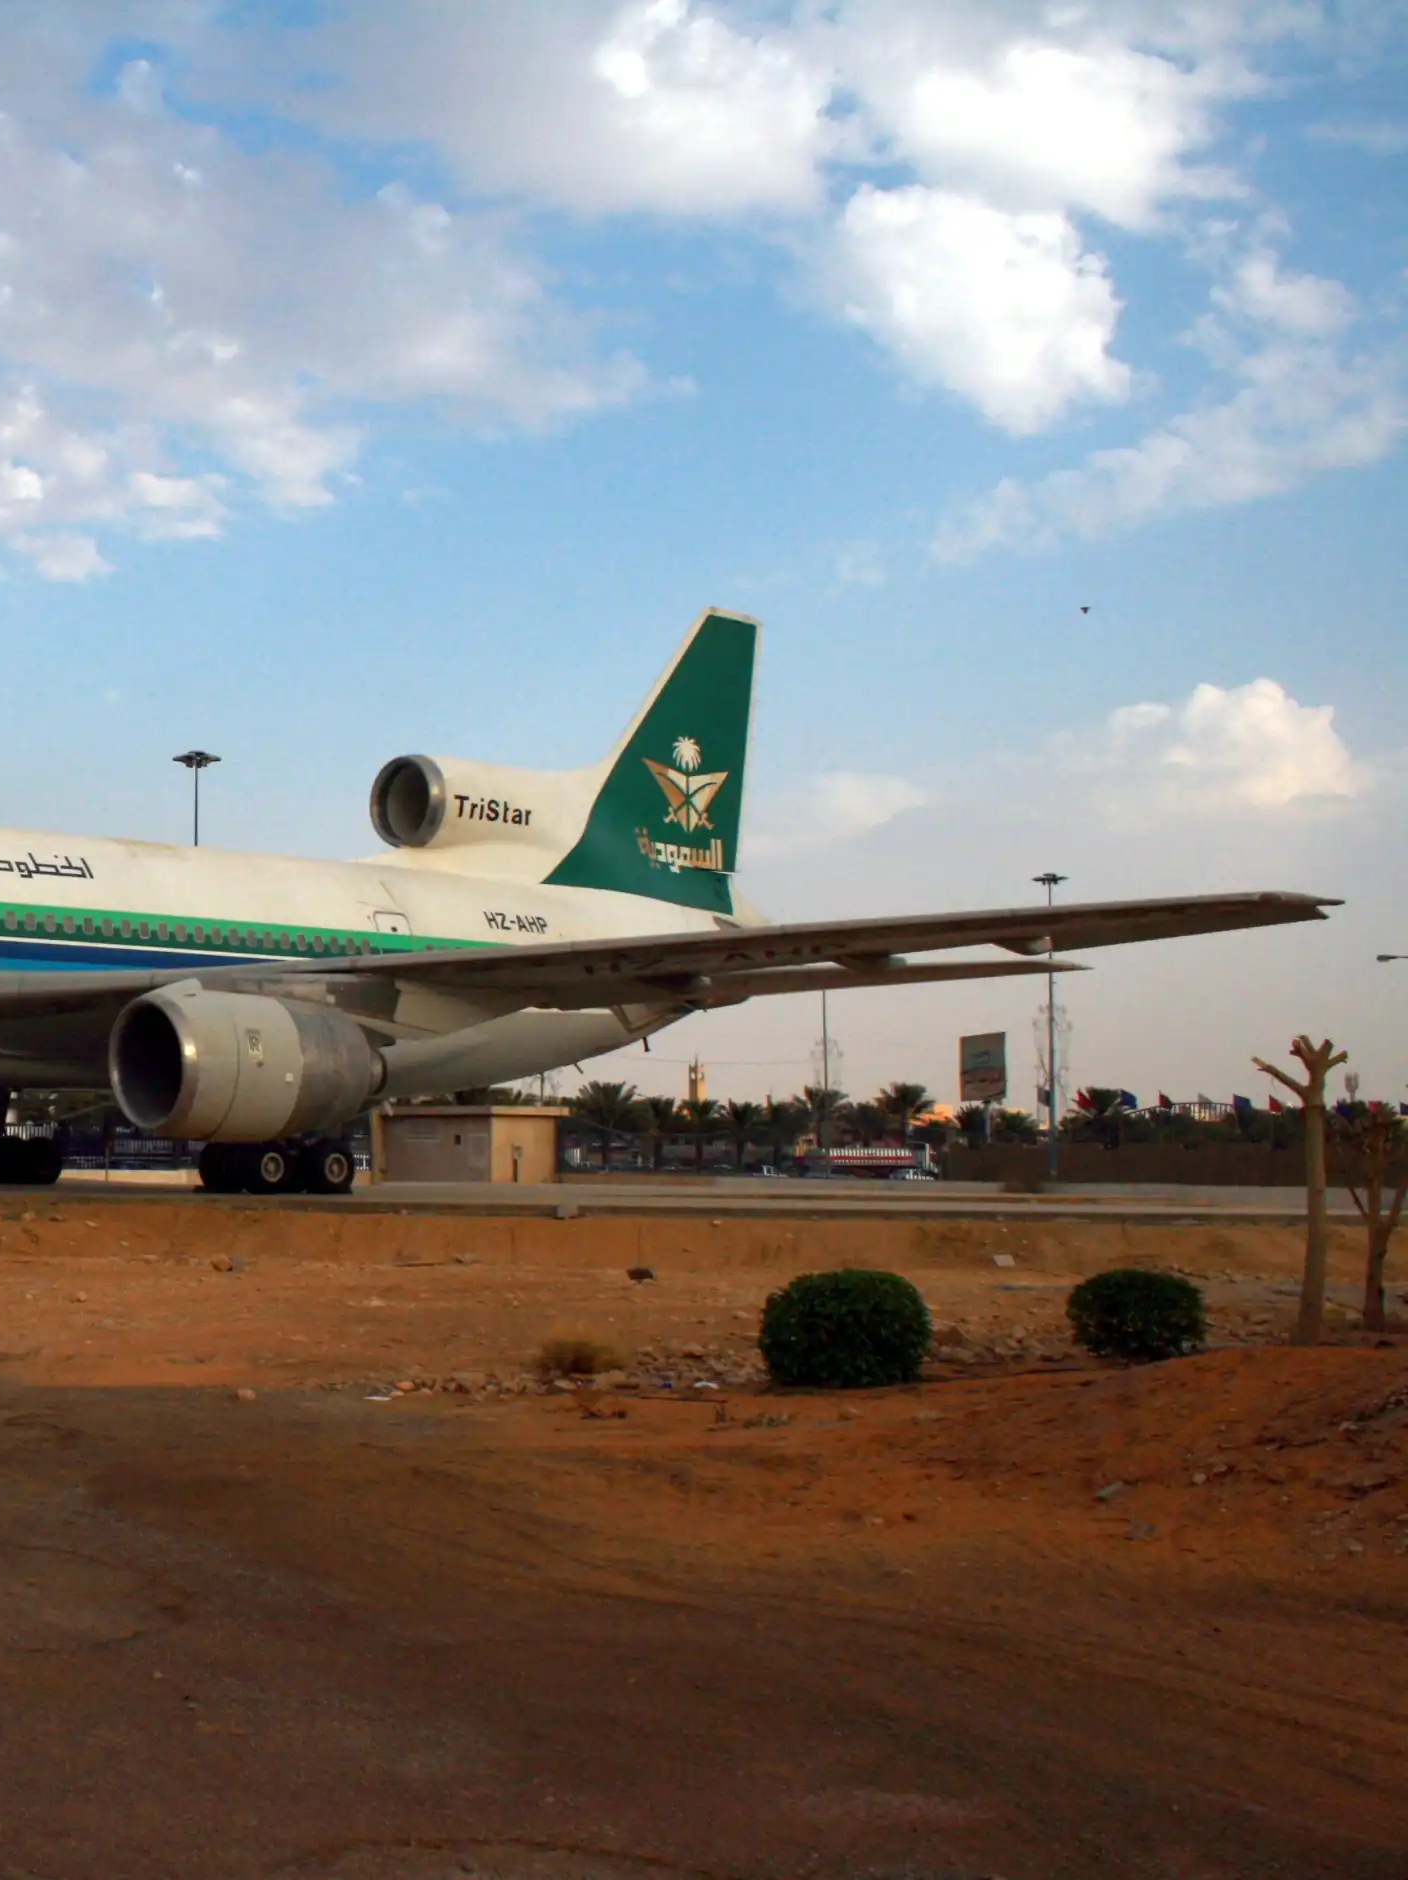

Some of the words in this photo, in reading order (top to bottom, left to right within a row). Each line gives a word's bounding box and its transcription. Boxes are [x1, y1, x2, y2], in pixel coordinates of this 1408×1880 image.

[454, 794, 532, 826] TriStar
[635, 827, 723, 873] السعودية
[483, 911, 548, 934] HZ-AHP
